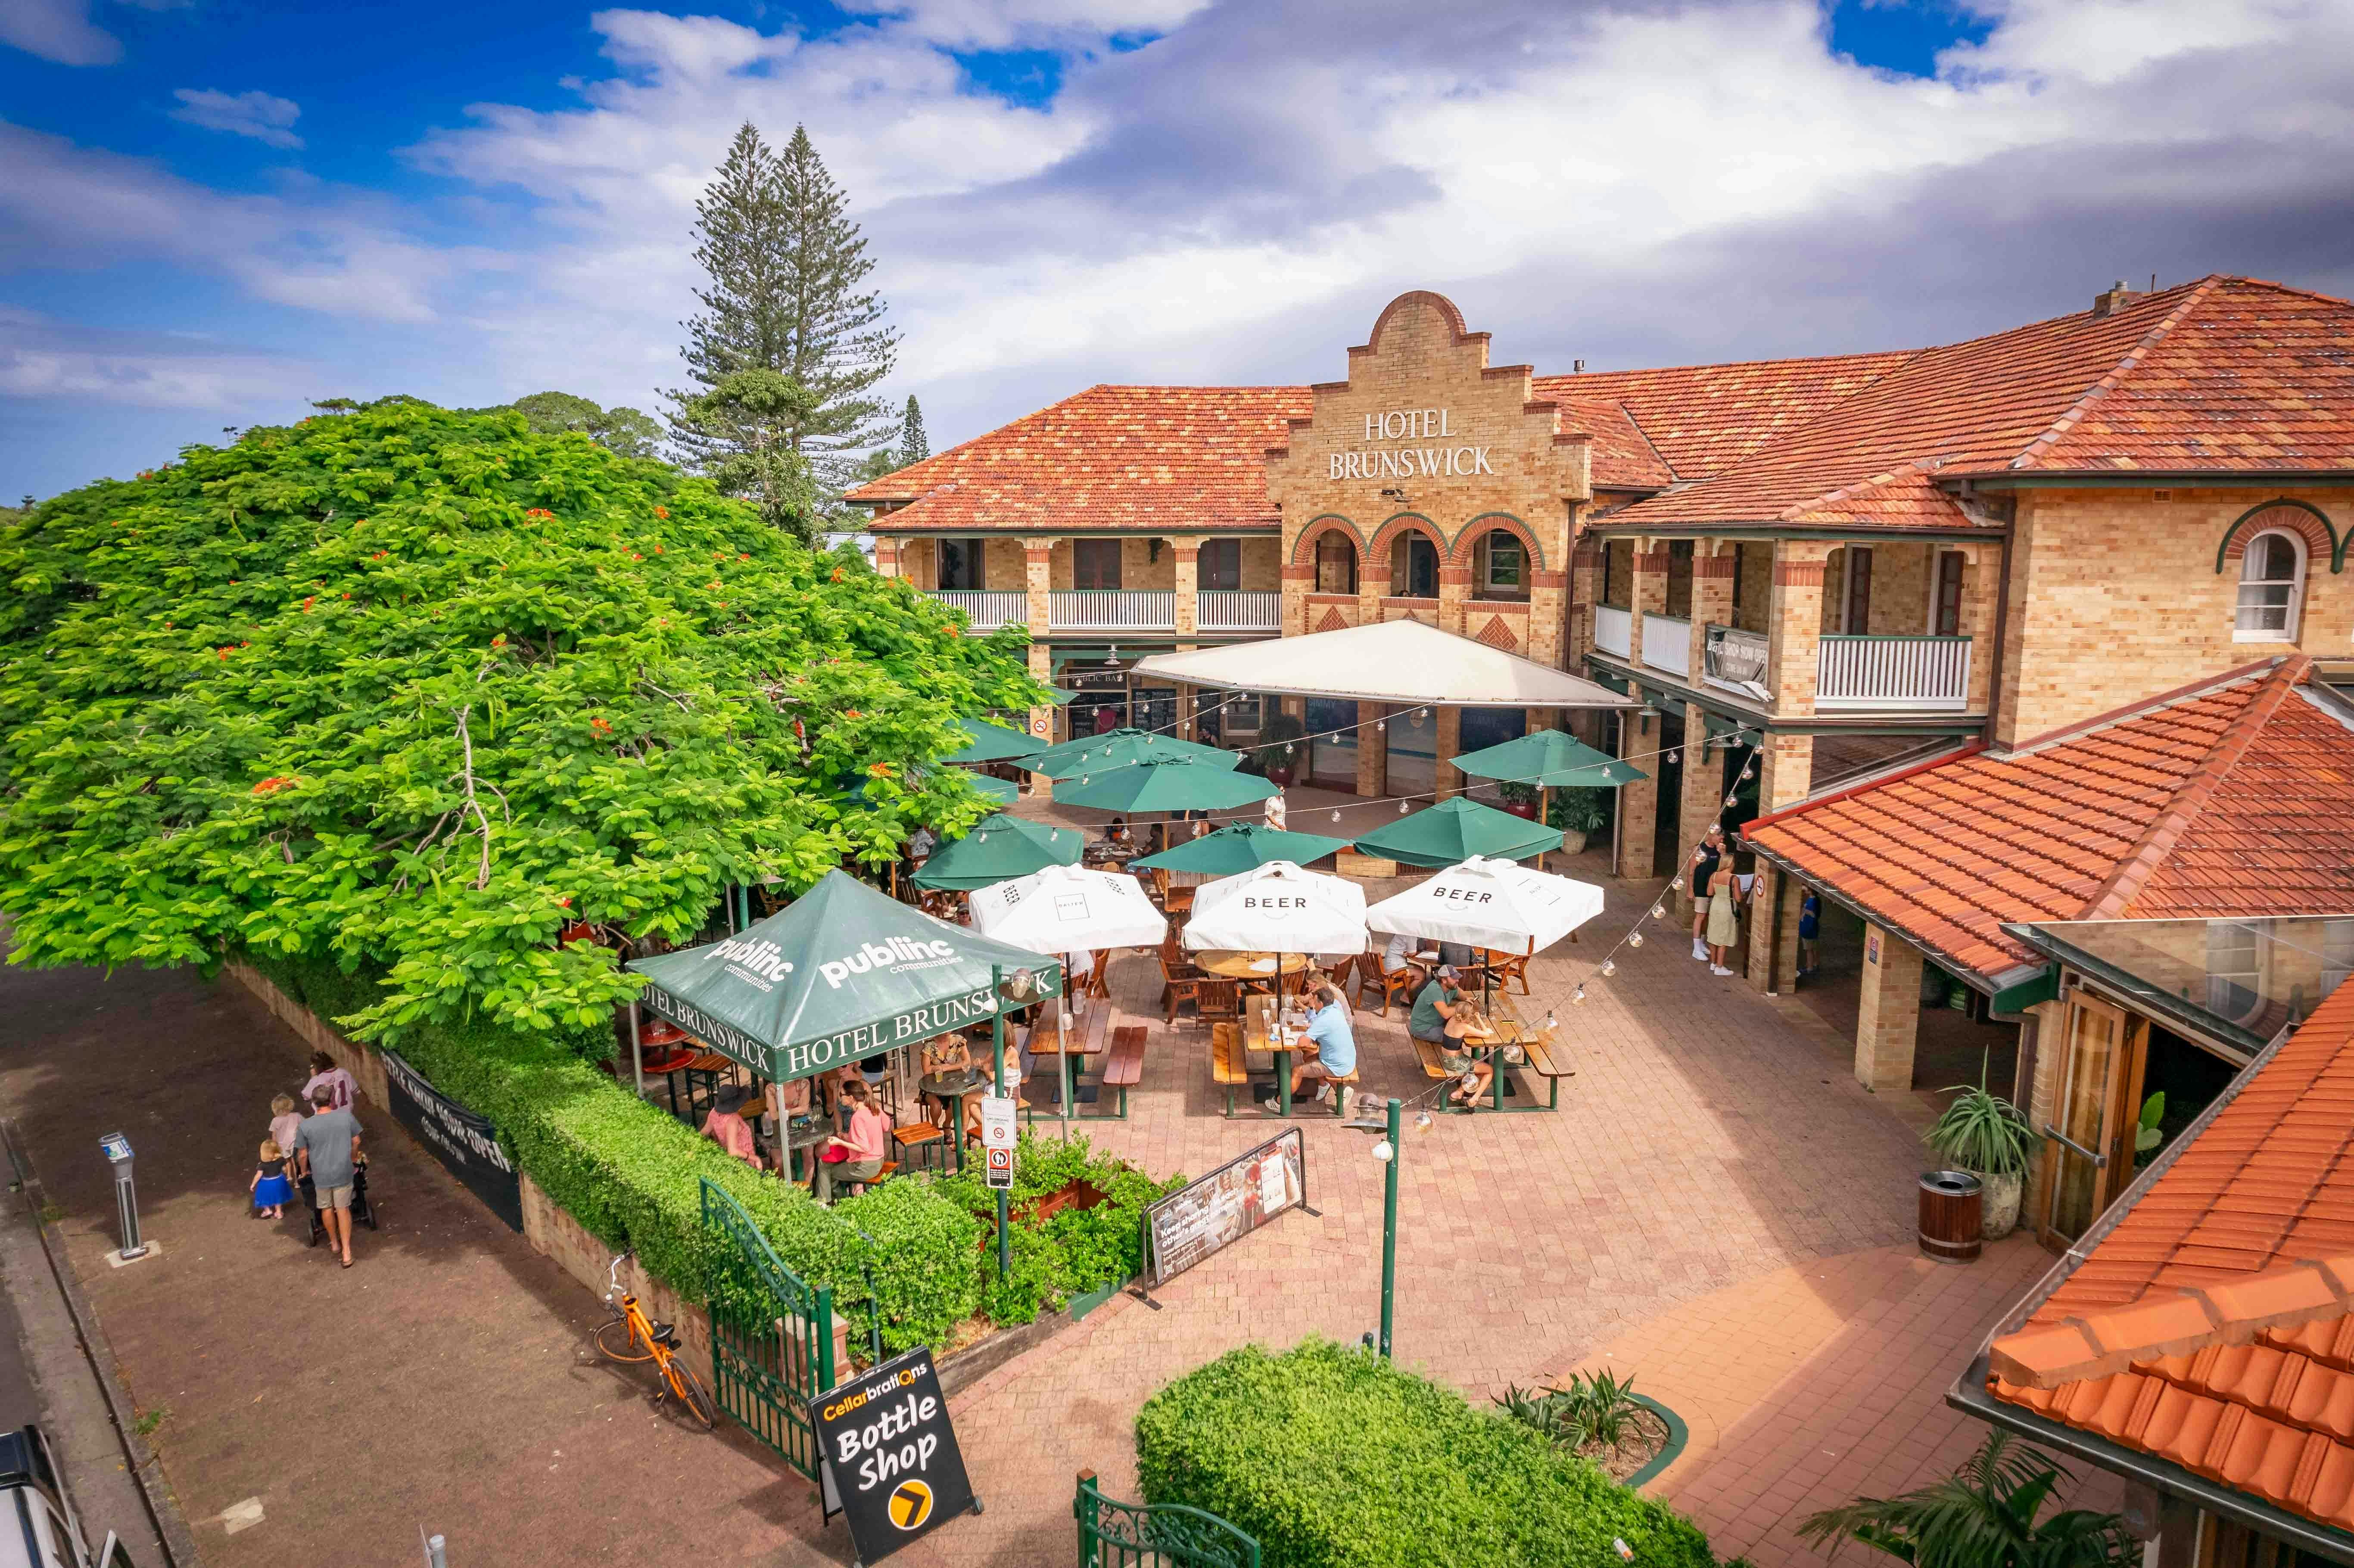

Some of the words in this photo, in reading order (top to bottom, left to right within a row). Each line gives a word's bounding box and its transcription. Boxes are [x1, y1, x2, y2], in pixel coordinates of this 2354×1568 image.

[1364, 409, 1457, 441] HOTEL
[1330, 446, 1494, 480] BRUNSWICK
[1003, 884, 1020, 906] BEER
[1245, 897, 1307, 908] BEER
[1433, 887, 1492, 903] BEER
[724, 963, 773, 992] communities
[889, 955, 964, 974] communities
[675, 999, 770, 1073] BRUNSWICK
[787, 1023, 888, 1074] HOTEL
[894, 969, 1053, 1041] BRUNSK
[1161, 1222, 1181, 1238] Keep
[1181, 1205, 1209, 1226] sharing
[1161, 1228, 1189, 1248] other's
[823, 1363, 928, 1422] Cellarbrations
[837, 1393, 937, 1463] Bottle
[858, 1433, 937, 1491] Shop
